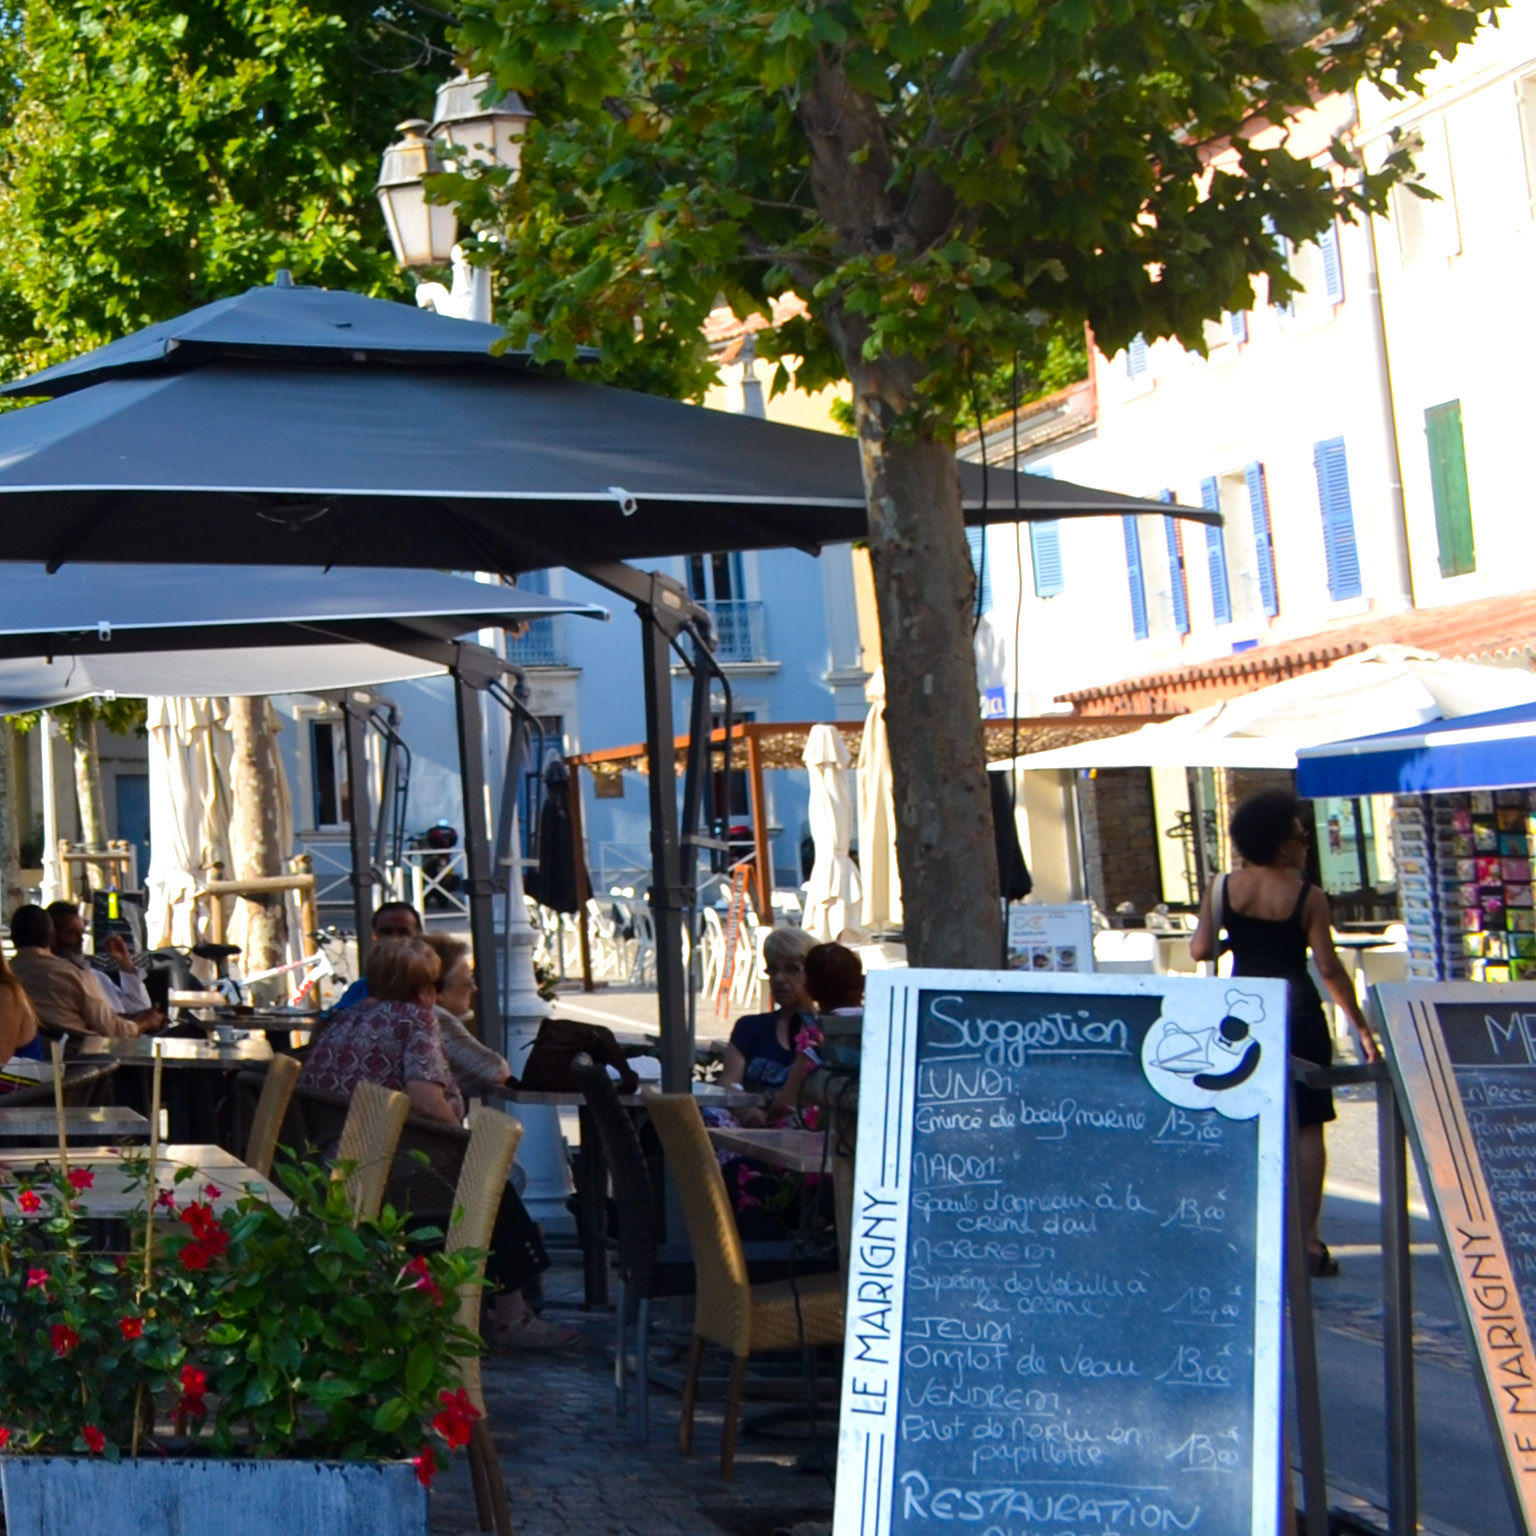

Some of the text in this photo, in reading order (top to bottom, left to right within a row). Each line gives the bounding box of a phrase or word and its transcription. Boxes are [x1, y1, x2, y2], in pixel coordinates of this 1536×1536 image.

[928, 995, 1128, 1067] Suggestion
[989, 1106, 1016, 1128] de
[850, 1190, 899, 1417] LE MARIGNY
[1456, 1225, 1536, 1414] MARIGNY
[1015, 1343, 1048, 1376] de
